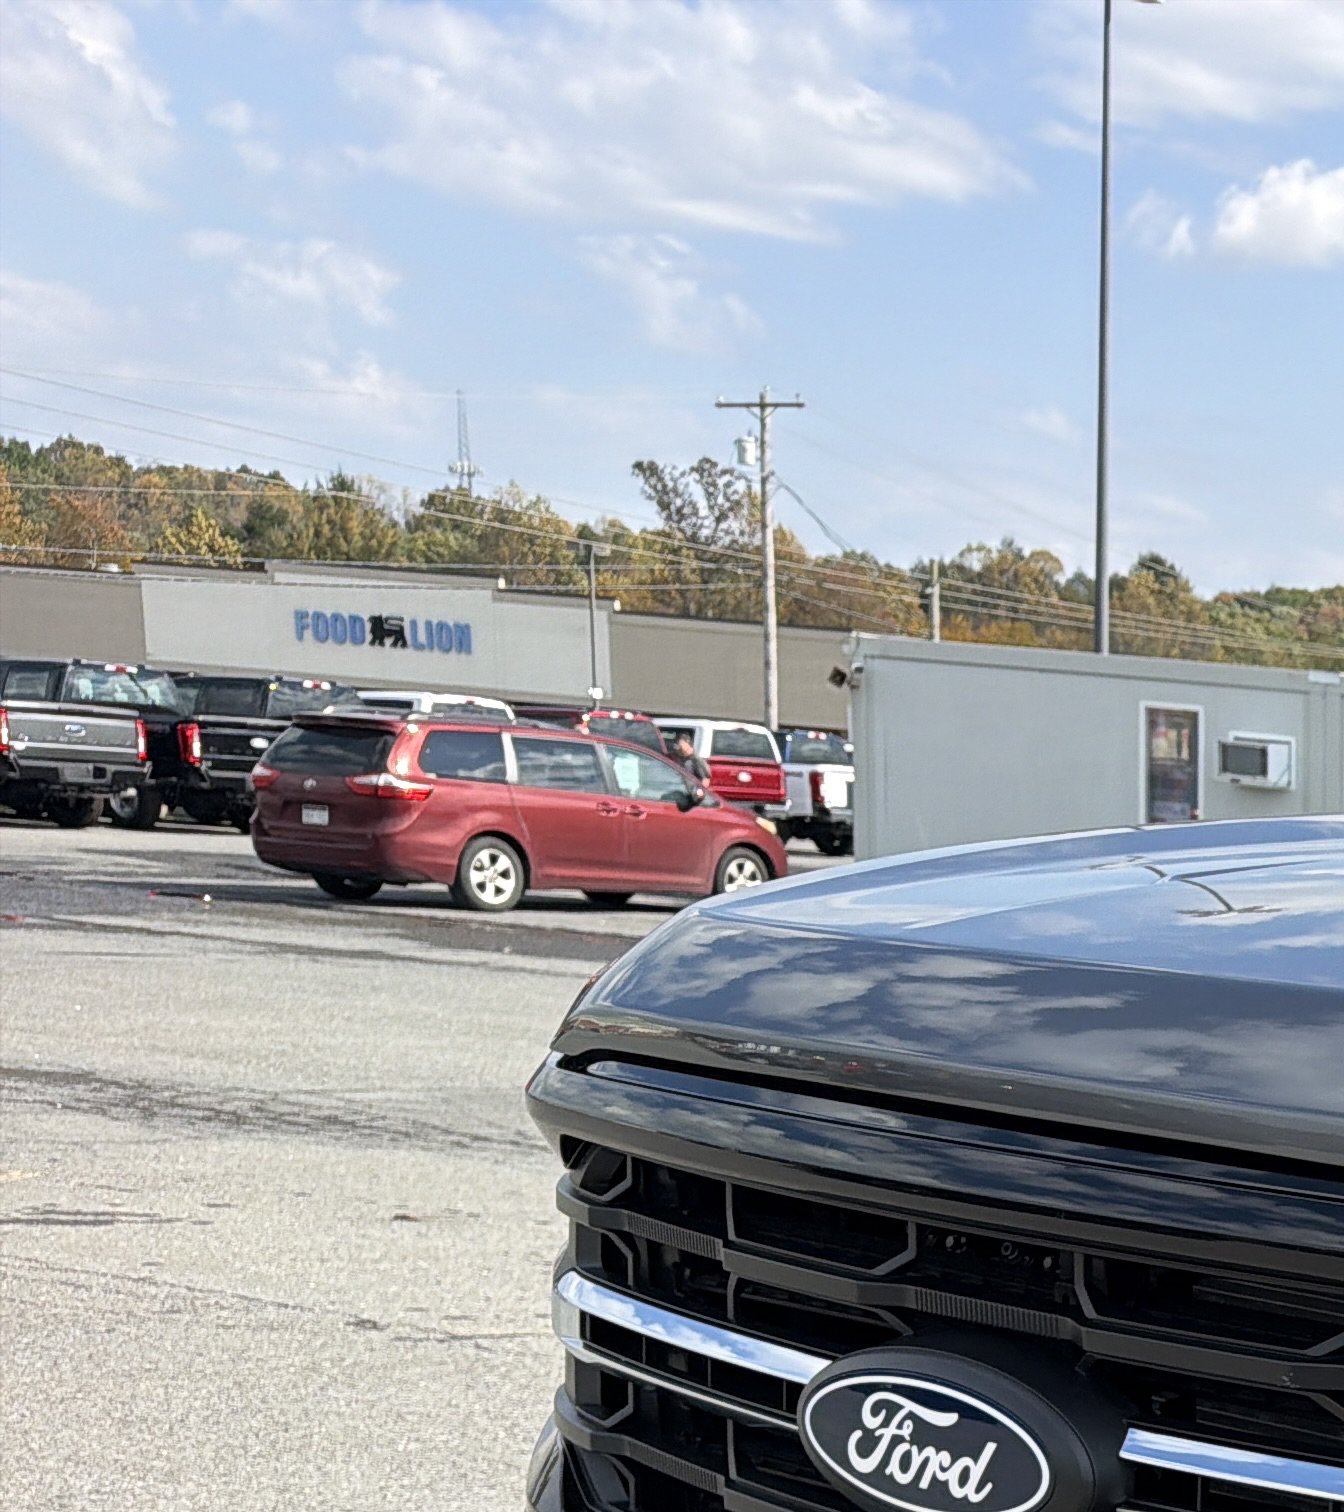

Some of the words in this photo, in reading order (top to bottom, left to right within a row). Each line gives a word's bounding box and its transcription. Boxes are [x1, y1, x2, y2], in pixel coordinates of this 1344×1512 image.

[294, 609, 366, 646] FOOD
[409, 618, 472, 655] LION
[848, 1391, 998, 1503] Ford
